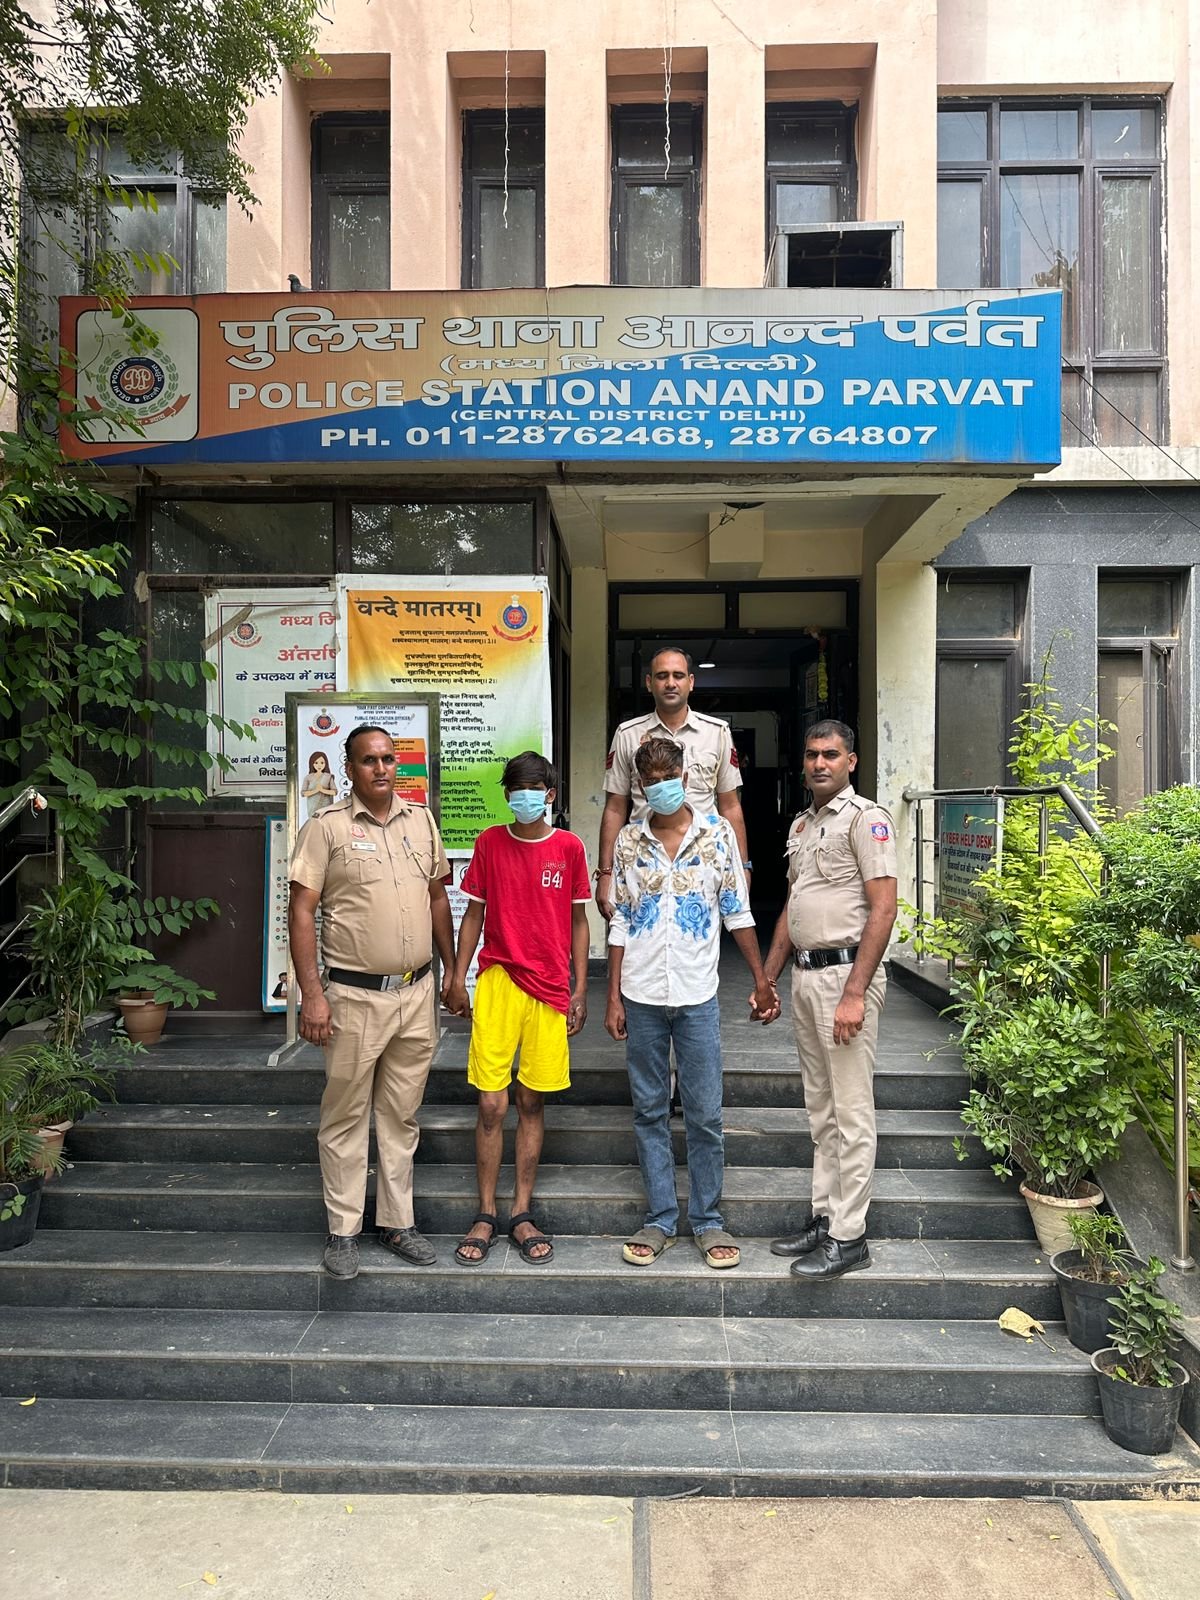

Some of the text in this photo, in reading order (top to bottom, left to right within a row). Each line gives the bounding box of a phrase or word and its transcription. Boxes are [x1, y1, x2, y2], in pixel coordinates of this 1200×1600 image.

[219, 300, 1045, 371] पुलिस थाना आनन्द पर्वत
[112, 361, 128, 384] POLICE
[440, 353, 817, 375] (मध्य जिला दिल्ली)
[228, 378, 1034, 410] POLICE STATION ANAND PARVAT
[451, 409, 806, 424] (CENTRAL DISTRICT DELHI)
[321, 426, 939, 450] PH. 011-28762468, 28764807
[355, 596, 400, 618] वन्दे
[280, 615, 314, 626] मध्य
[235, 670, 248, 681] के
[252, 672, 295, 681] उपलक्ष्य
[299, 669, 312, 680] में
[258, 705, 268, 714] के
[960, 833, 975, 847] HELP
[976, 834, 992, 849] DESK
